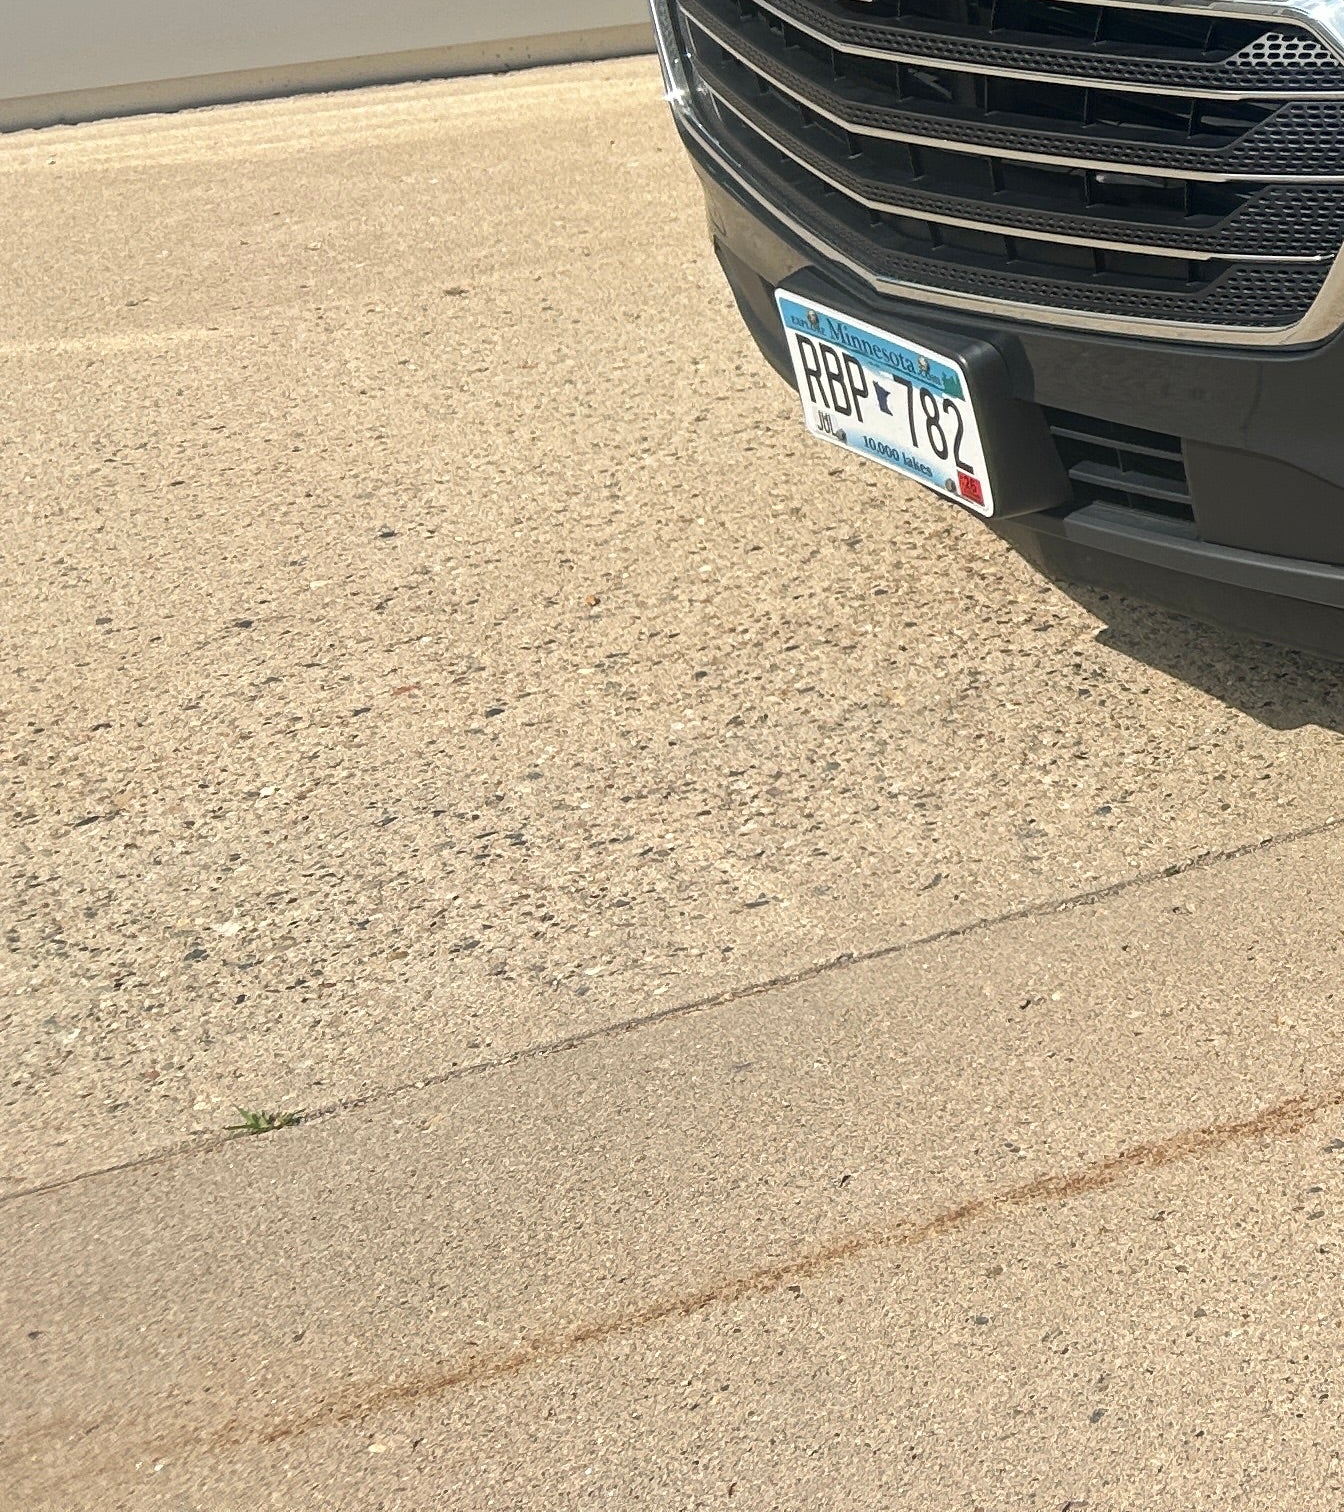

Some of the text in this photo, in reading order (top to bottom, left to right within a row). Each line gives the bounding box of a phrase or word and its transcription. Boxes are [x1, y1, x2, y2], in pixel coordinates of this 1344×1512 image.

[827, 318, 915, 374] Minnesota
[795, 333, 975, 475] RBP 782
[902, 451, 934, 477] lakes
